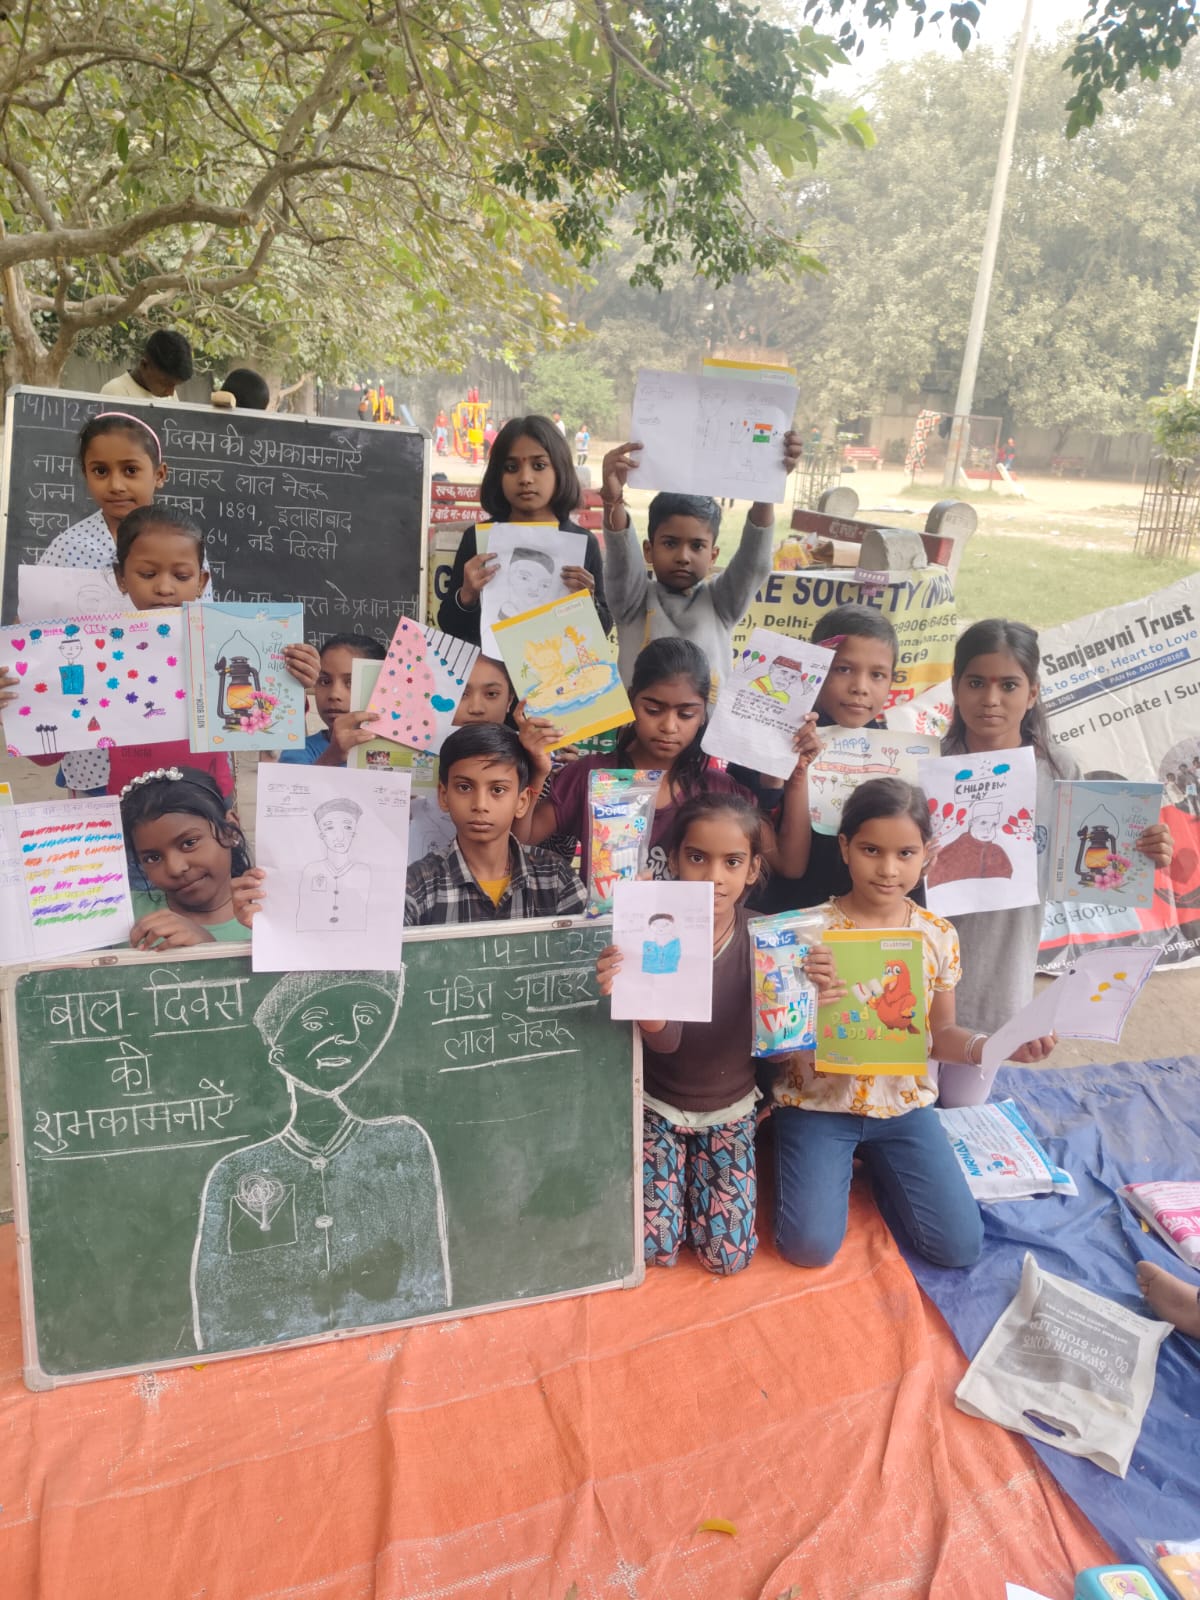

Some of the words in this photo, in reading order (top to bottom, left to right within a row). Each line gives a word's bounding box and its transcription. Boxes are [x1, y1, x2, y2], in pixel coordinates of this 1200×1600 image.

[162, 418, 216, 453] दिवस
[219, 423, 245, 456] की
[32, 454, 75, 478] नाम
[28, 482, 75, 502] जन्म
[235, 474, 276, 496] लाल
[275, 505, 352, 533] इलाहाबाद
[247, 526, 281, 553] नई
[283, 530, 339, 560] दिल्ली
[1042, 625, 1135, 676] Sanjeevni
[1135, 604, 1195, 639] Trust
[1054, 680, 1069, 690] to
[1110, 648, 1148, 669] Heart
[1149, 643, 1164, 653] to
[1166, 629, 1198, 648] Love
[1110, 674, 1126, 684] PAN
[1099, 697, 1162, 727] Donate
[481, 931, 609, 963] 14-11-25
[424, 975, 496, 1015] पंडित
[504, 966, 598, 1006] जवाहर
[444, 1025, 499, 1060] लाल
[502, 1012, 576, 1048] नेहरू
[105, 1041, 153, 1091] की
[1050, 1326, 1089, 1349] STORE
